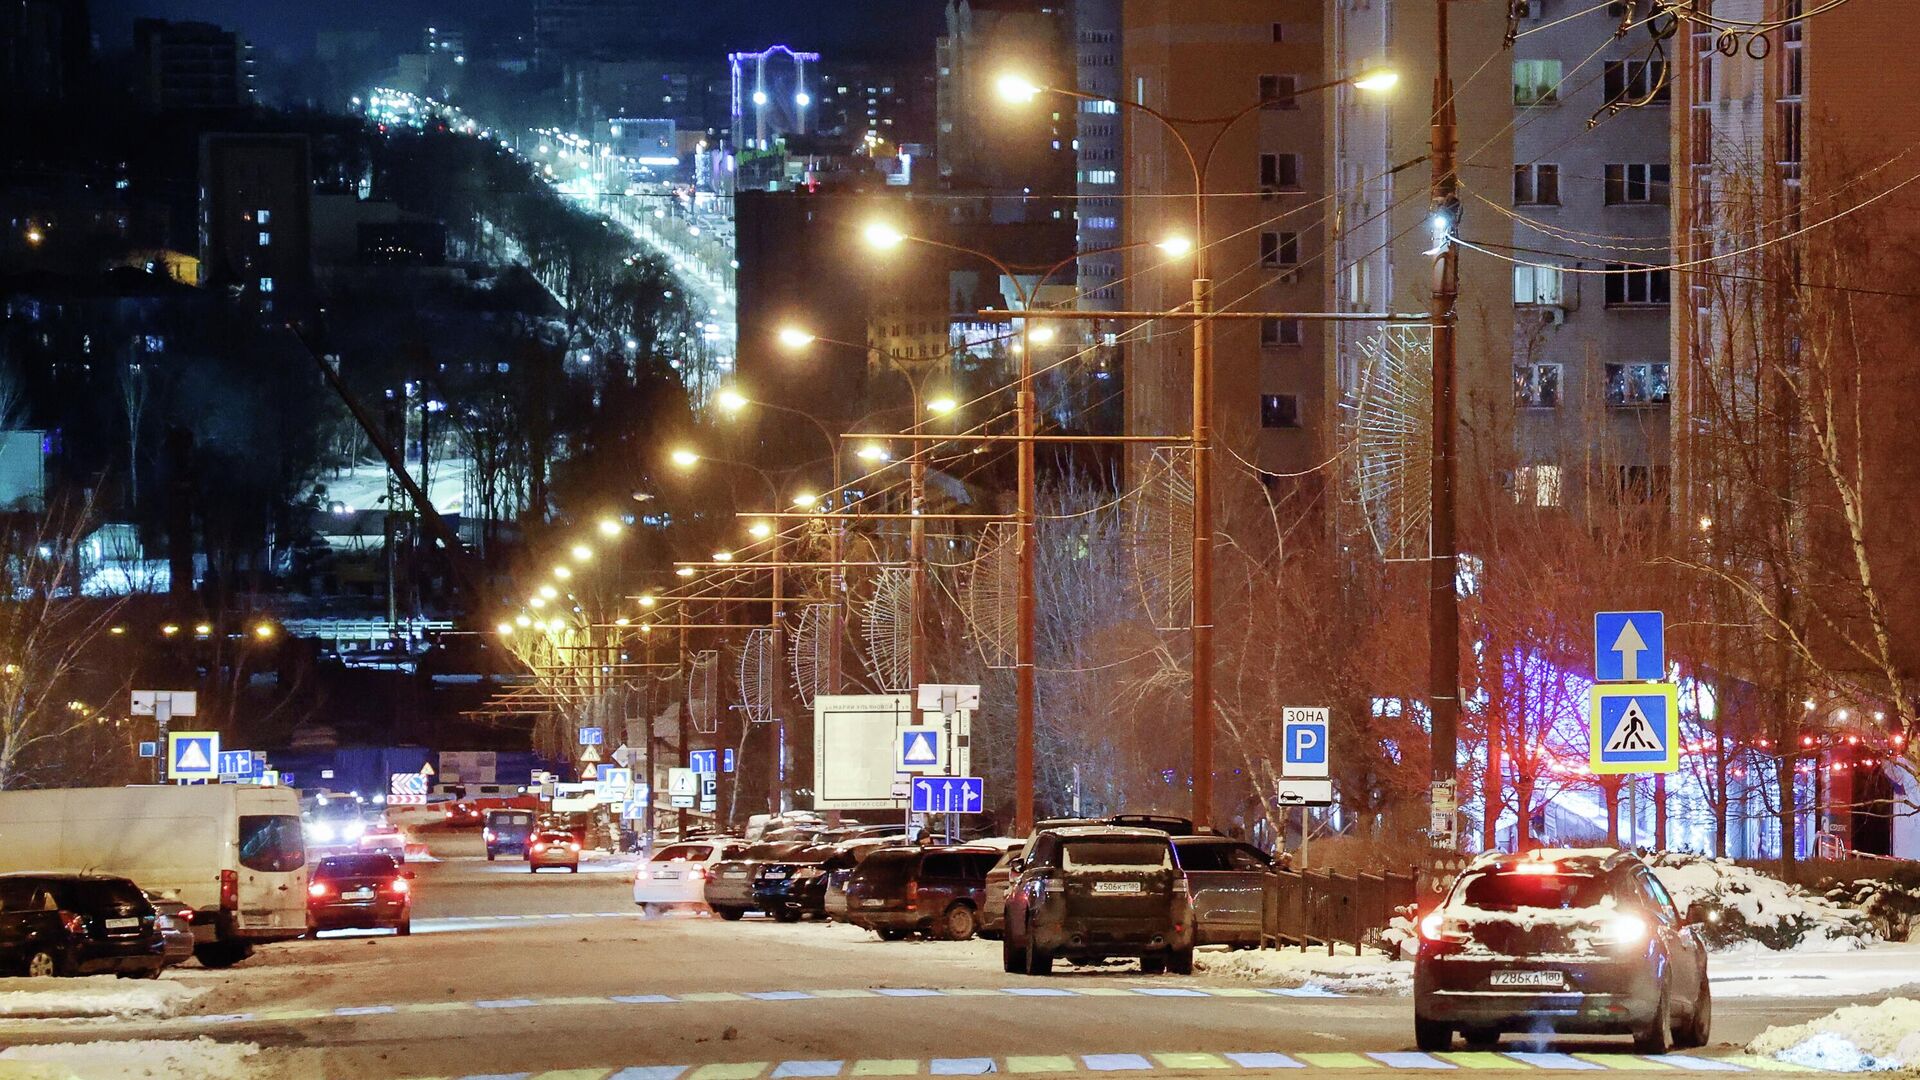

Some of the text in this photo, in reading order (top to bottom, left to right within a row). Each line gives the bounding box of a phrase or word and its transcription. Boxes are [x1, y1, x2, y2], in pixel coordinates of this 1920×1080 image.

[1287, 710, 1325, 722] ЗОНА
[1296, 729, 1317, 760] P
[1494, 972, 1539, 984] У286КА
